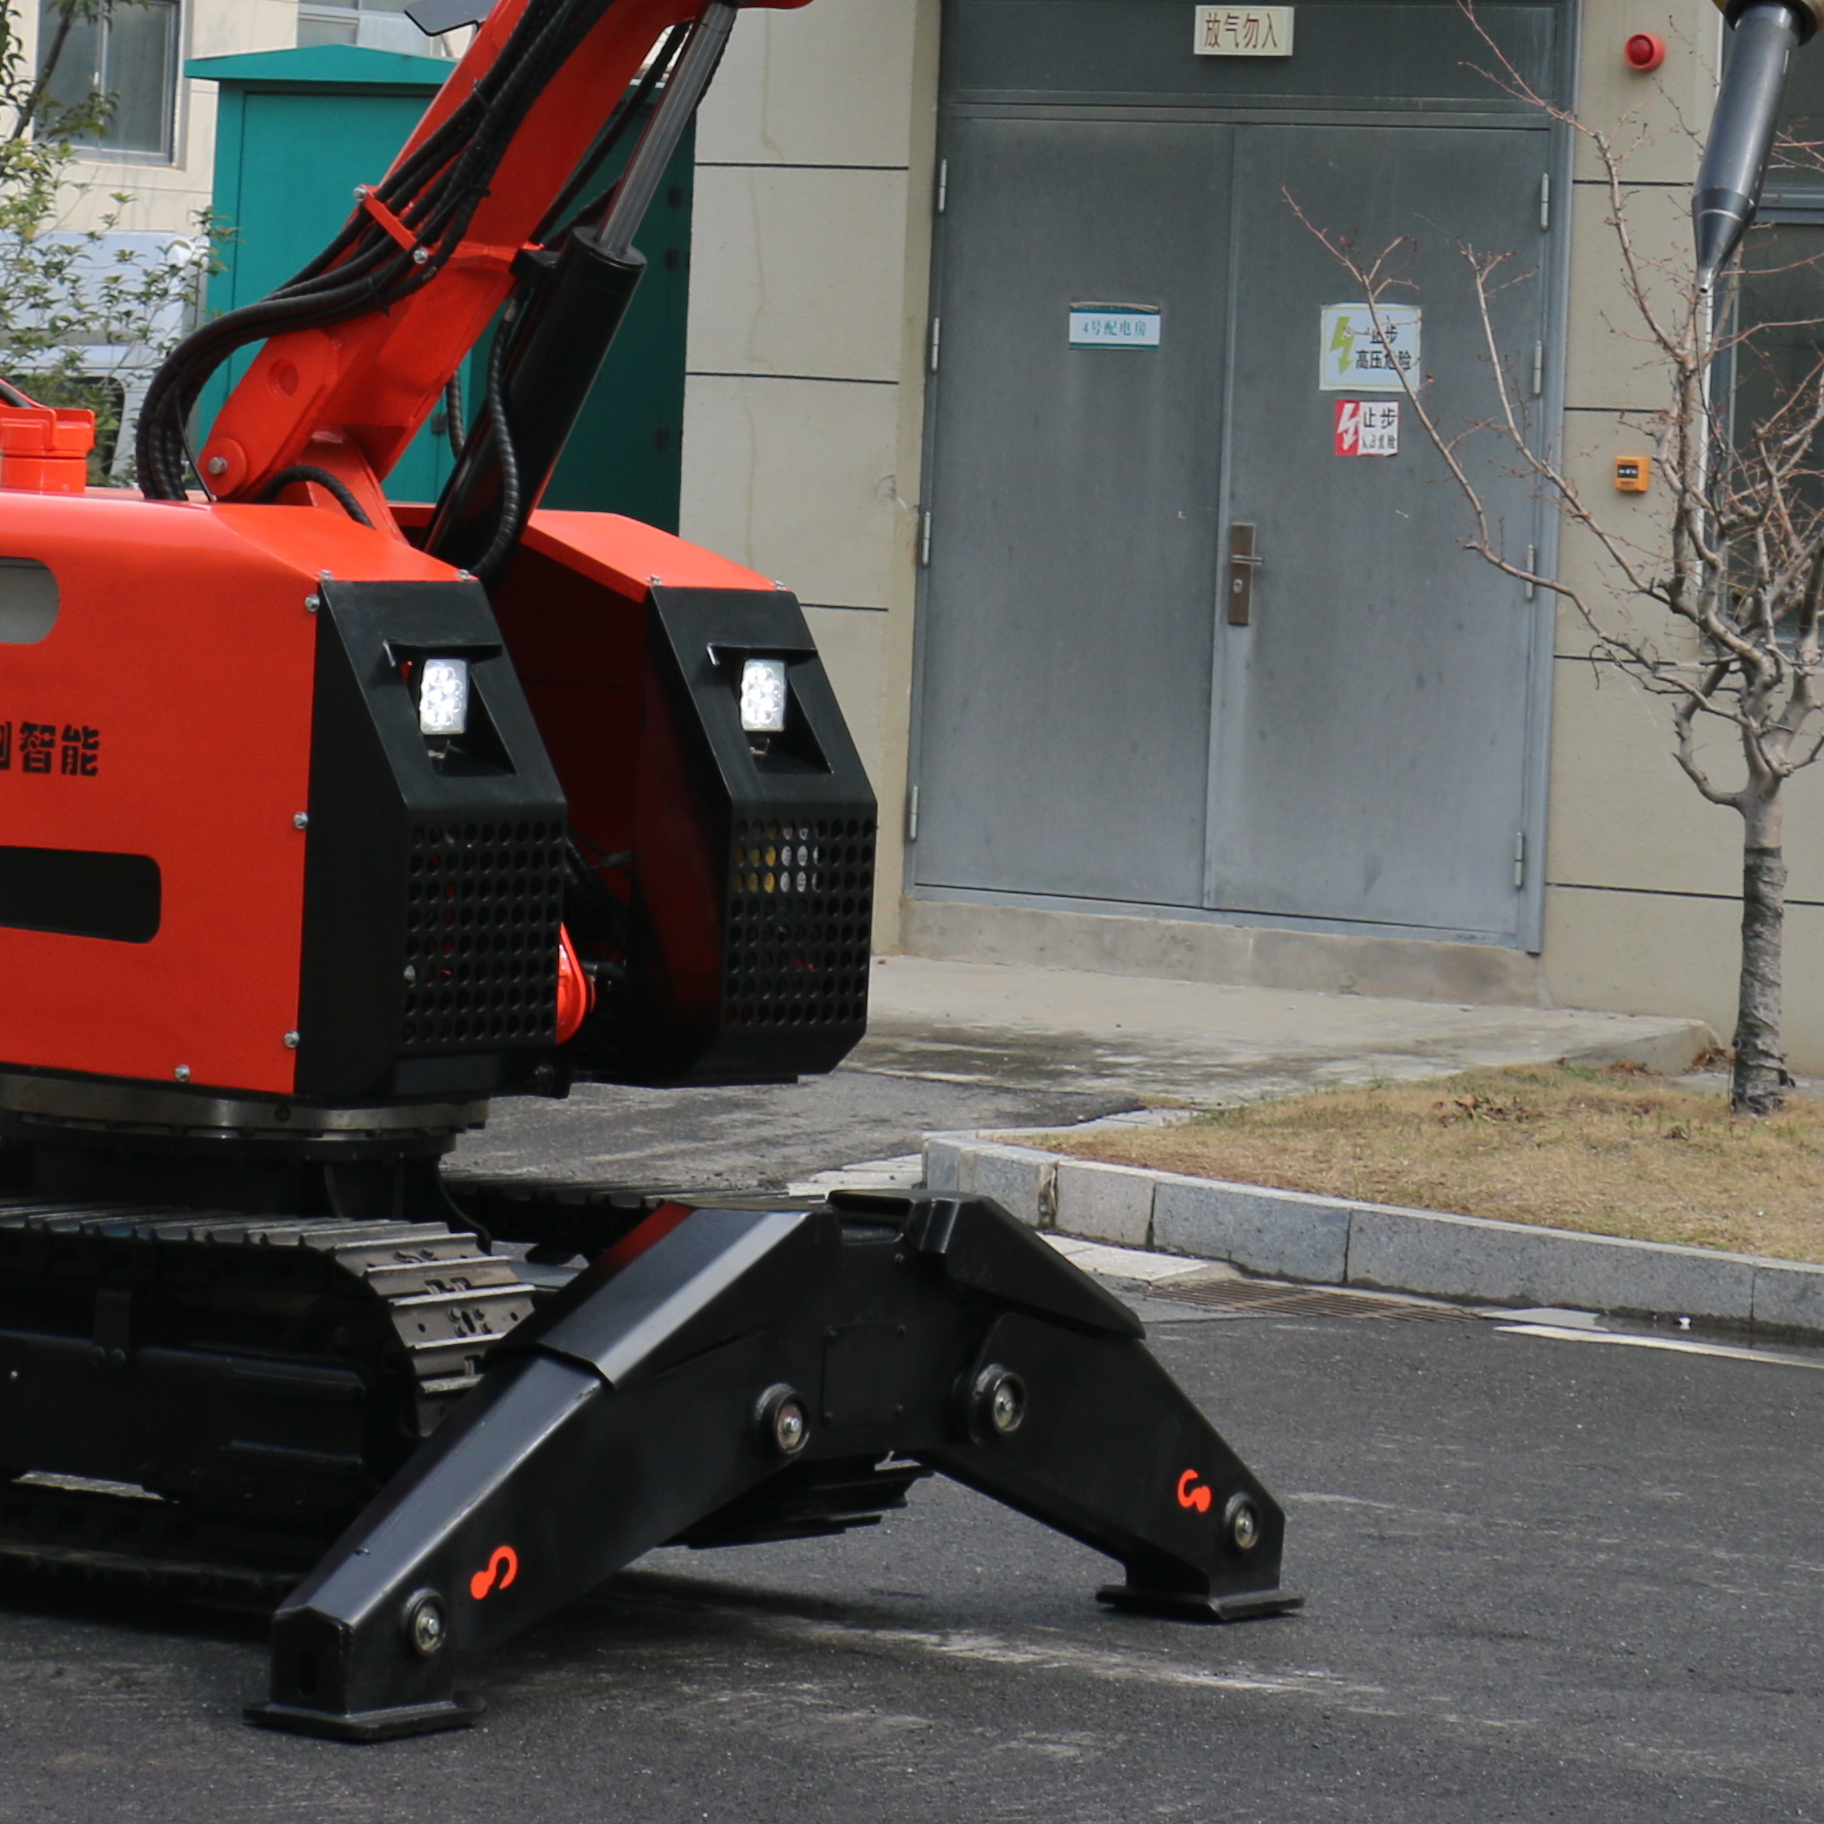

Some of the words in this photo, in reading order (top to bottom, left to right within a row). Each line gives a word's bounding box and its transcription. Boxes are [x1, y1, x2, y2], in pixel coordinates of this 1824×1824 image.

[1204, 11, 1278, 49] 放气勿入
[1082, 320, 1148, 337] 4号配电房
[1356, 349, 1412, 371] 高压危险
[1363, 407, 1398, 430] 止步
